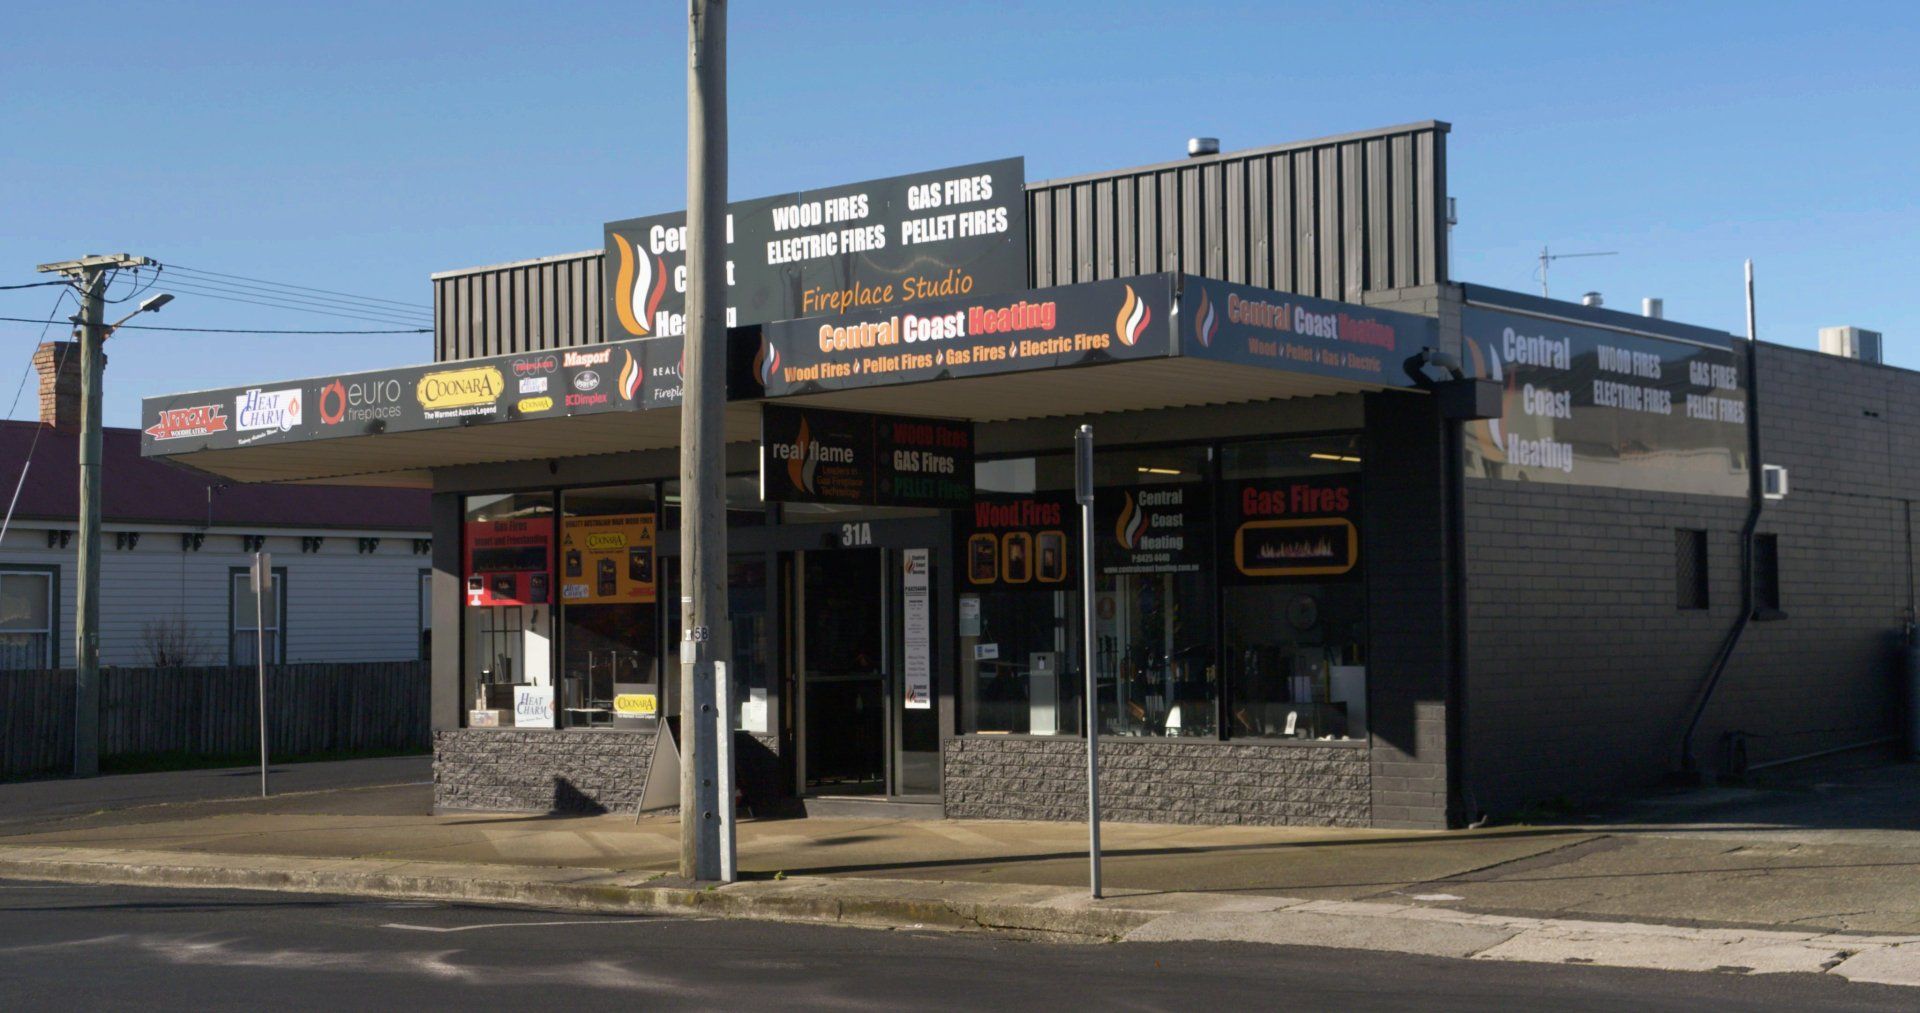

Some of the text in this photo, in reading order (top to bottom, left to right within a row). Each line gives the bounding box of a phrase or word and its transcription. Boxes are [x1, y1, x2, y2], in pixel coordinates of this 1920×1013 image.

[908, 174, 993, 211] GAS FIRES
[772, 193, 869, 232] WOOD FIRES
[901, 206, 1008, 246] PELLET FIRES
[766, 224, 886, 265] ELECTRIC FIRES
[803, 267, 974, 315] Fireplace Studio
[819, 301, 1056, 353] Central Coast Heating
[1228, 292, 1395, 352] Central Coast Heating
[563, 348, 612, 368] Masport
[784, 332, 1110, 383] Wood Fires Pellet Fires Gas Fires Electric Fires
[1248, 337, 1278, 357] Wood
[1503, 326, 1571, 371] Central
[653, 365, 676, 377] REAL
[1597, 344, 1661, 380] WOOD FIRES
[1689, 360, 1737, 391] GAS FIRES
[246, 389, 280, 412] HEAT
[348, 379, 401, 407] euro
[425, 373, 494, 402] COONARA
[1523, 382, 1571, 419] Coast
[1593, 379, 1672, 416] ELECTRIC FIRES
[158, 405, 222, 430] ARROW
[240, 398, 293, 430] CHARM
[348, 404, 401, 422] fireplaces
[424, 411, 434, 420] The
[458, 406, 477, 416] Aussie
[477, 404, 497, 416] Legend
[1686, 393, 1745, 424] PELLET FIRES
[893, 422, 968, 449] WOOD Fires
[772, 441, 854, 464] real flame
[893, 449, 955, 475] GAS Fires
[1507, 433, 1573, 473] Heating
[1138, 489, 1183, 507] Central
[1243, 484, 1349, 516] Gas Fires
[975, 500, 1061, 528] Wood Fires
[1152, 513, 1183, 528] Coast
[842, 522, 872, 547] 31A
[1140, 536, 1184, 551] Heating
[517, 701, 552, 720] CHARM
[520, 692, 544, 706] HEAT
[618, 697, 654, 711] COONARA
